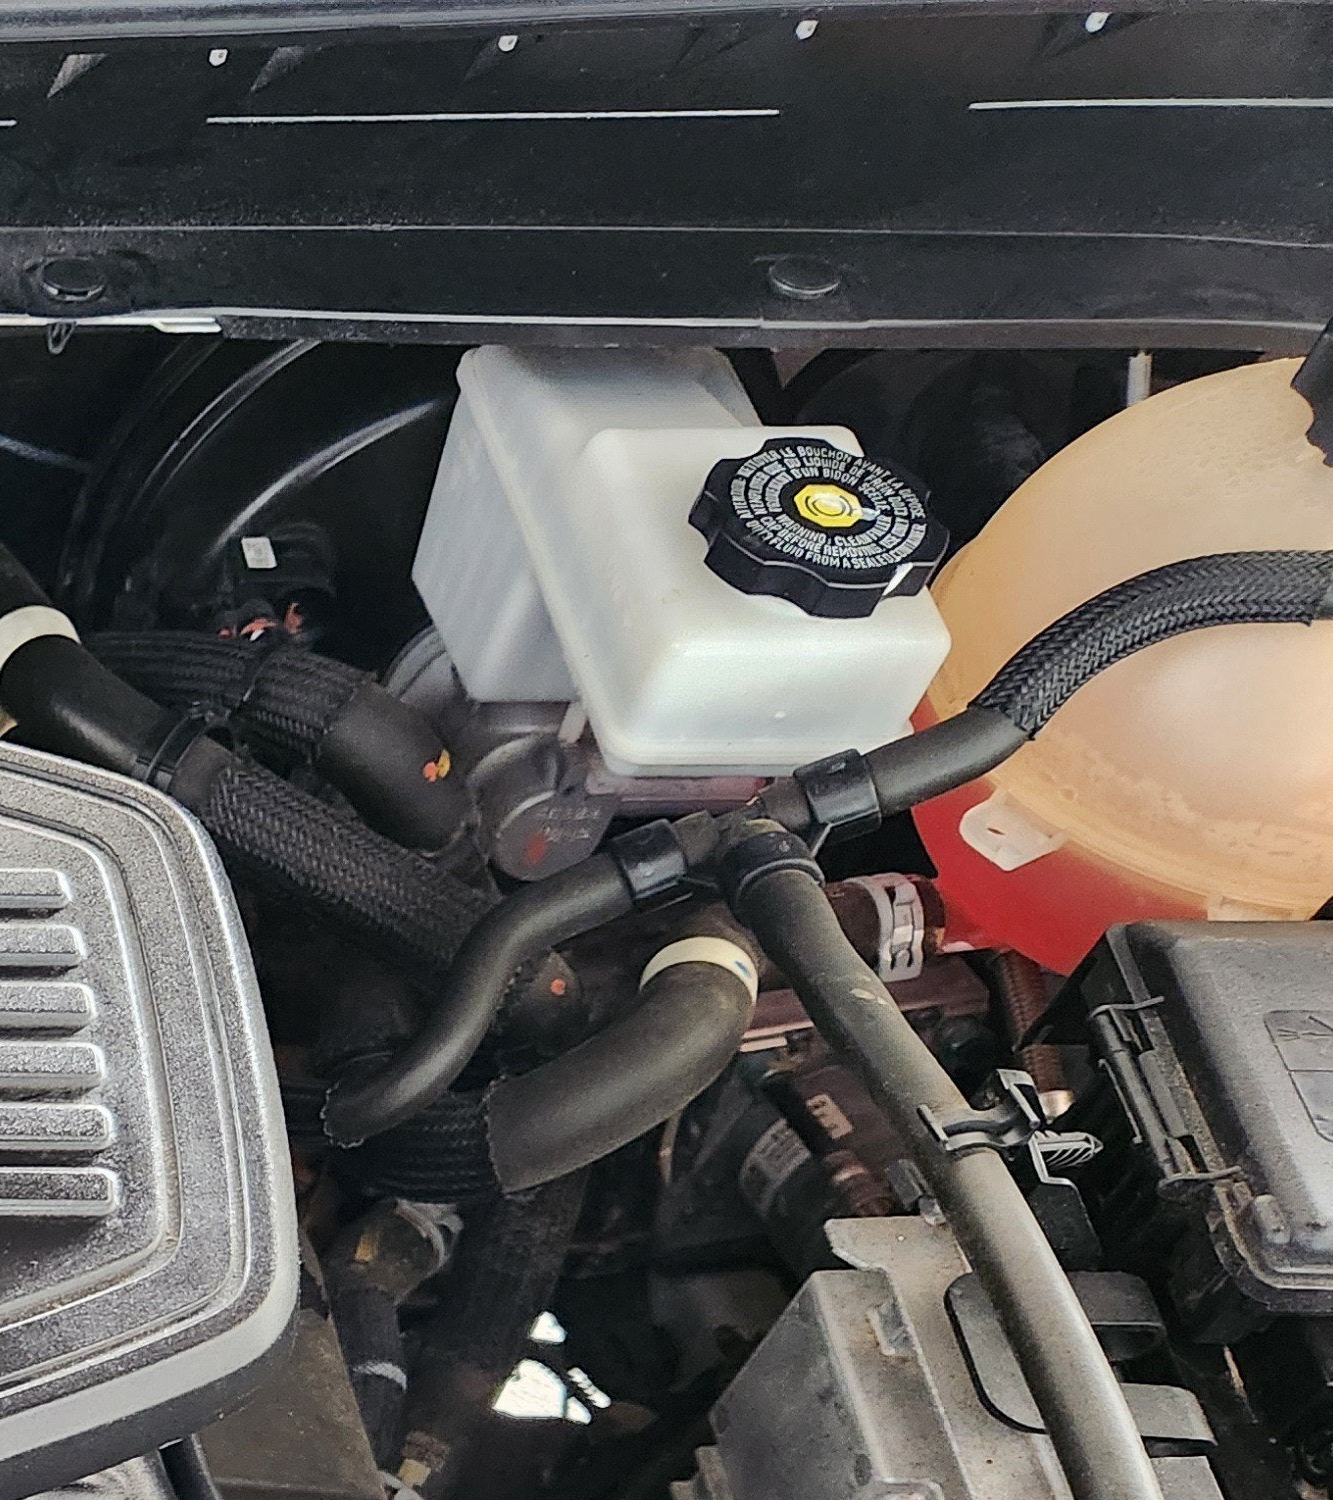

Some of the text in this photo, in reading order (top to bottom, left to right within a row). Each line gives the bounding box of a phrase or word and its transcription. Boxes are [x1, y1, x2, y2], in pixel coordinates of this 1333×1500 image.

[796, 445, 852, 463] BOUCHON
[853, 458, 891, 479] AVANT
[802, 456, 847, 472] LIQUIDE
[849, 466, 865, 478] DE
[822, 468, 859, 486] BIDON
[776, 528, 822, 554] BEFORE
[804, 550, 841, 568] FROM
